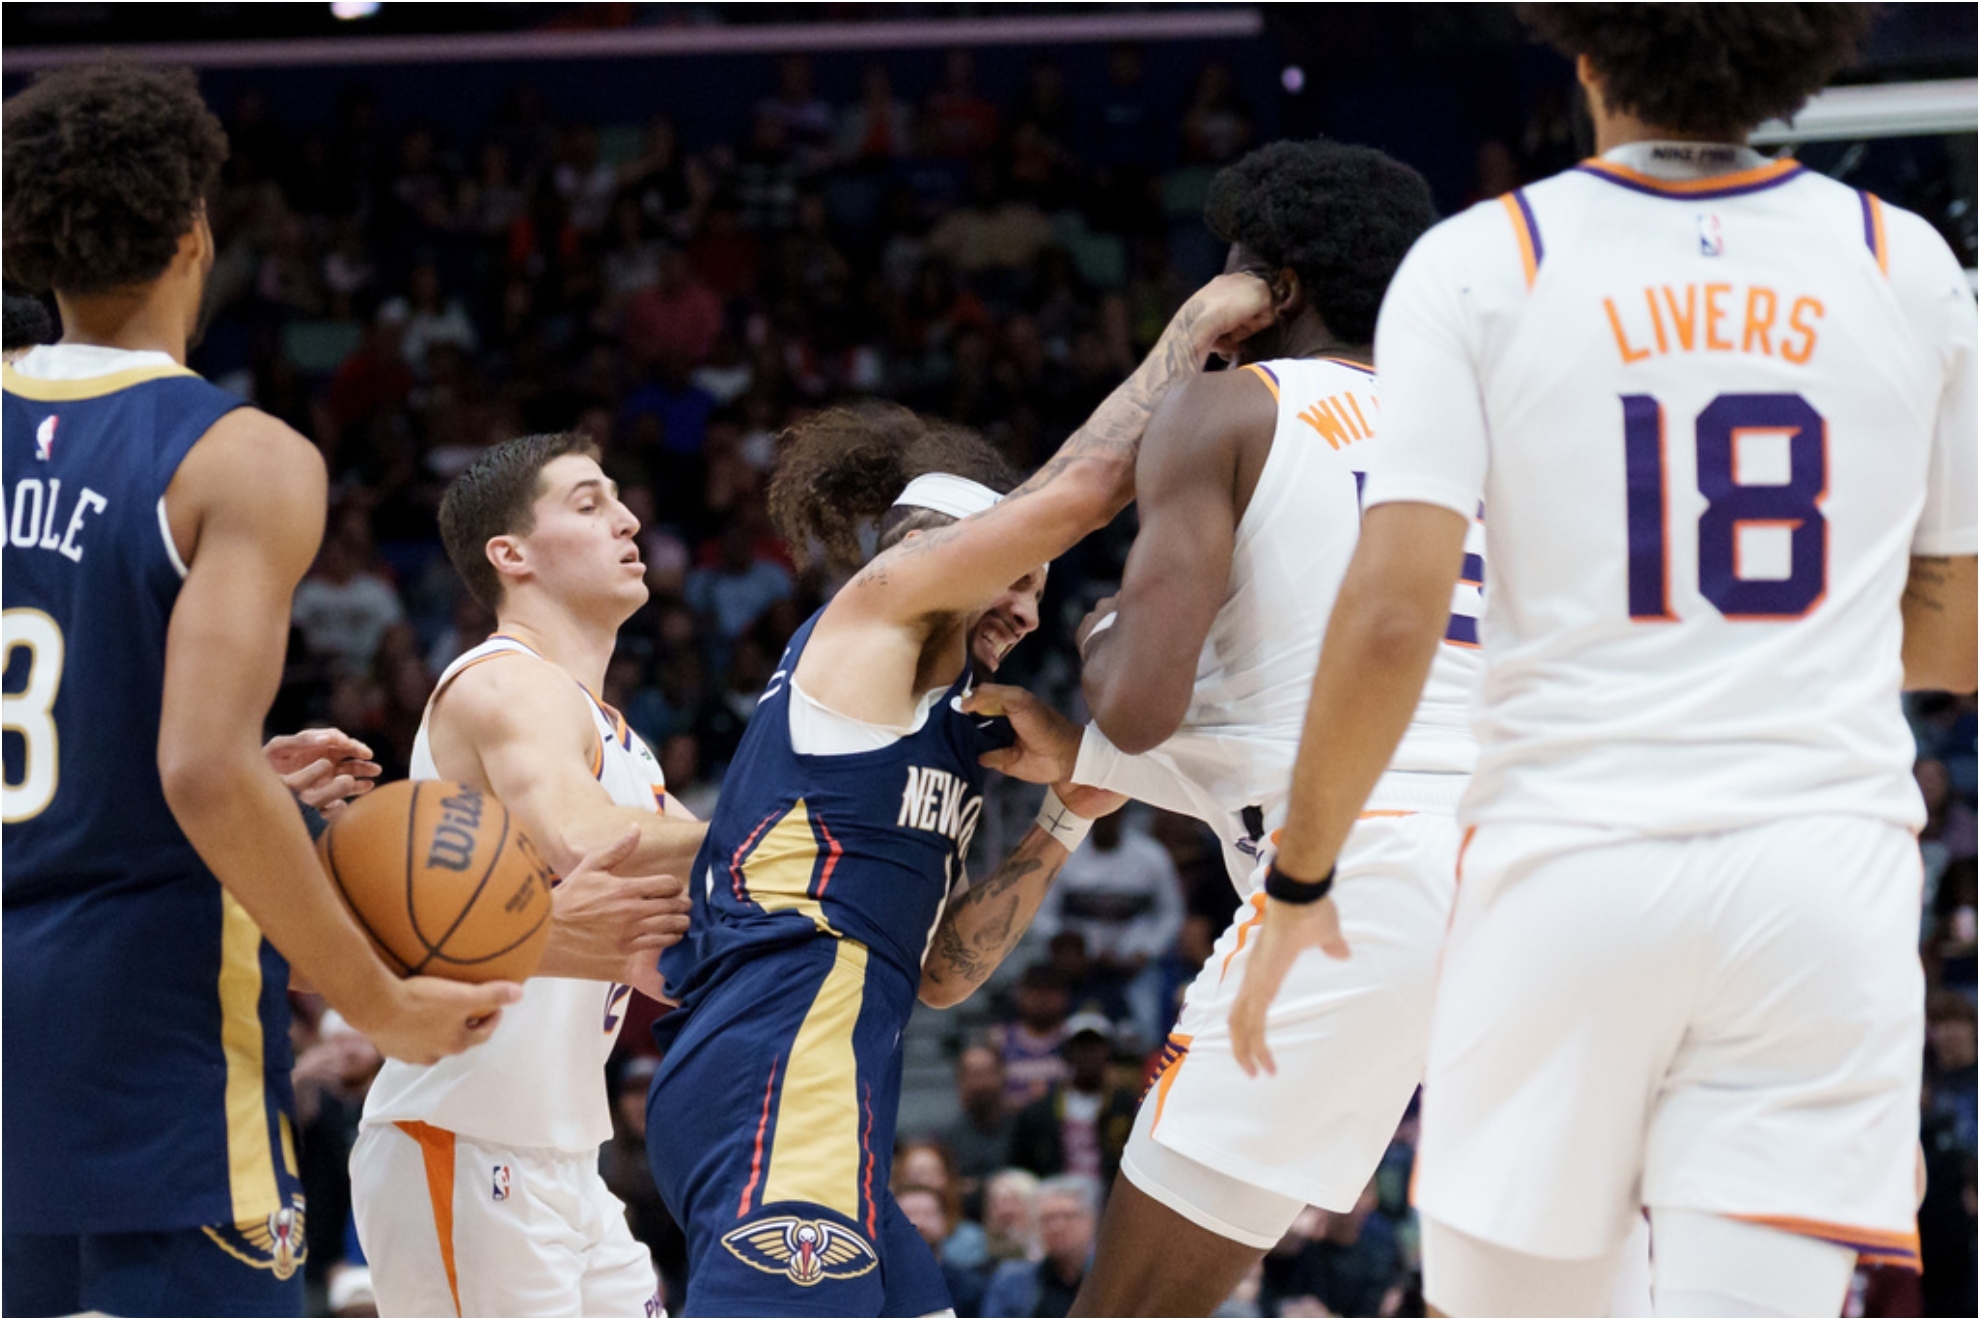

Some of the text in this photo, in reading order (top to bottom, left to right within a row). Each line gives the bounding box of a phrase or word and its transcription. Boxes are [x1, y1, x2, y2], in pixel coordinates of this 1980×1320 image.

[1603, 284, 1825, 365] LIVERS
[1297, 391, 1381, 451] WIL
[2, 478, 108, 563] OLE
[1617, 392, 1830, 622] 18
[897, 765, 968, 840] NEW
